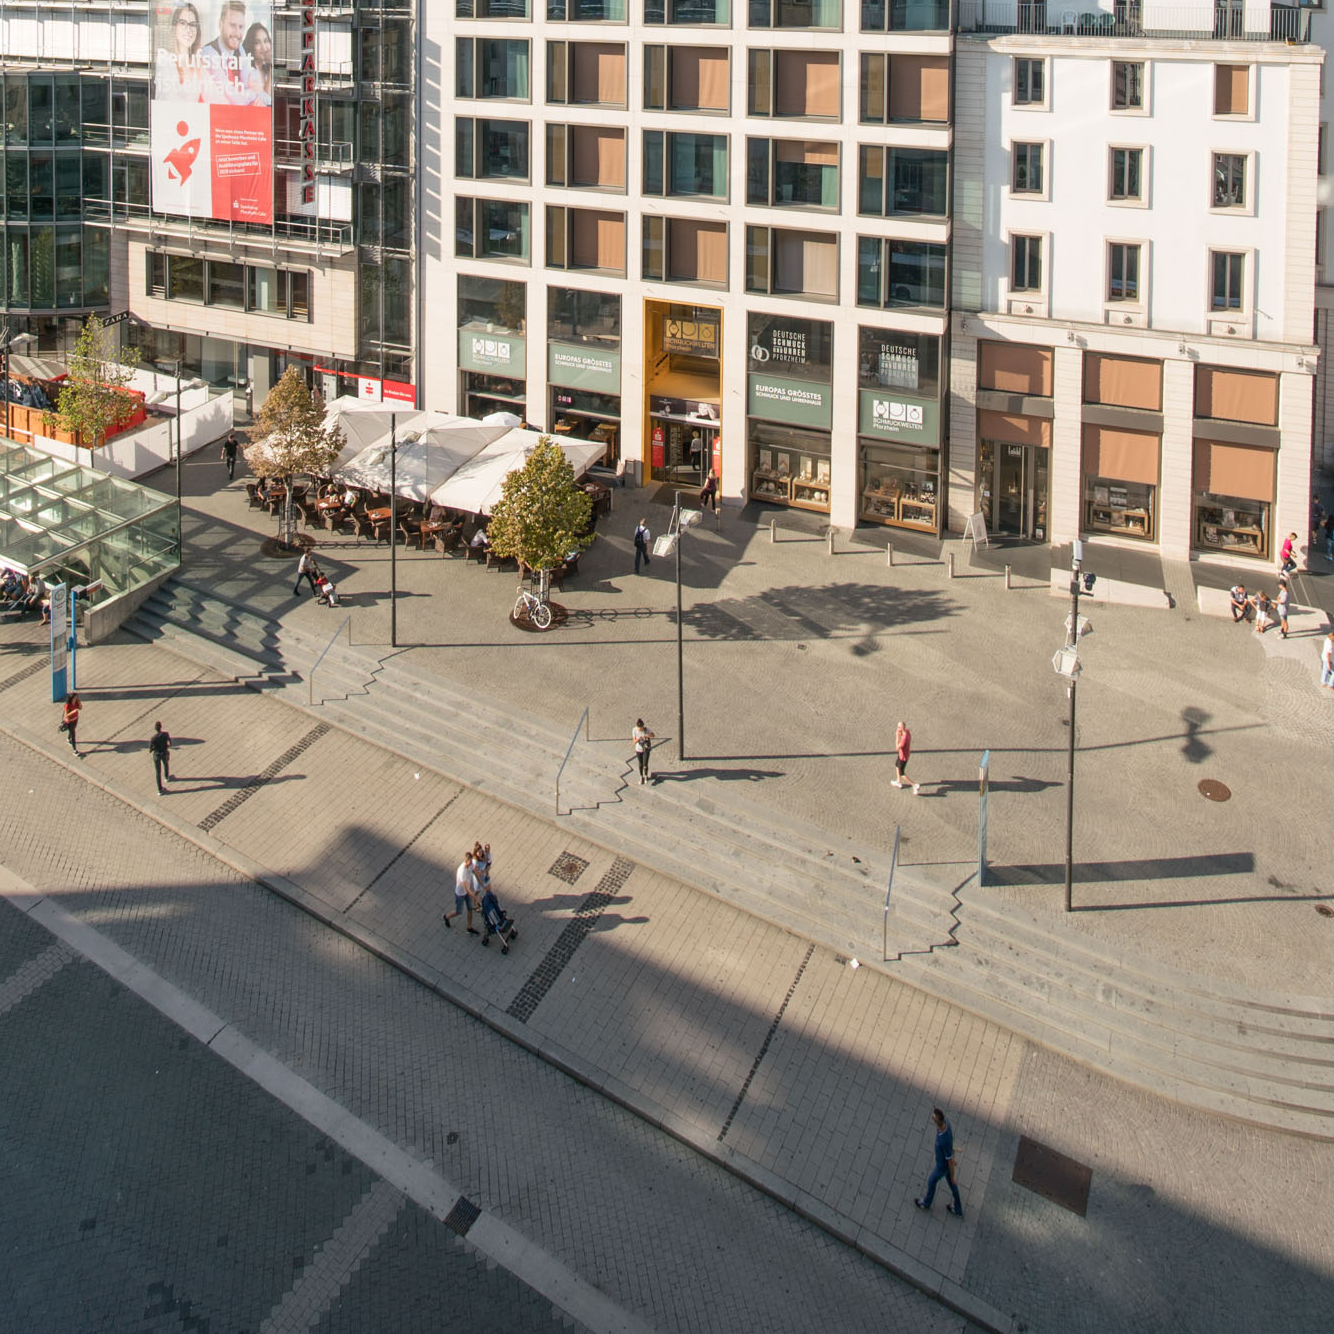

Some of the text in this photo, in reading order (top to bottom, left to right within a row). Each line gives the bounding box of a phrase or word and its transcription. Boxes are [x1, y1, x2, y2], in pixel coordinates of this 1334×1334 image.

[156, 48, 254, 70] Berufsstart
[302, 9, 316, 203] SPARKASSE
[105, 313, 127, 326] ZARA
[772, 330, 806, 341] DEUTSCHE
[772, 338, 806, 349] SCHMUCK
[881, 344, 916, 356] DEUTSCHE
[555, 354, 612, 368] EUROPAS GRÖSSTES
[772, 354, 806, 363] PFORZHEIM
[755, 384, 822, 401] EUROPAS GRÖSSTES
[755, 391, 779, 399] SCHMUCK
[872, 417, 923, 430] SCHMUCKWELTEN
[872, 423, 899, 432] Pforzheim
